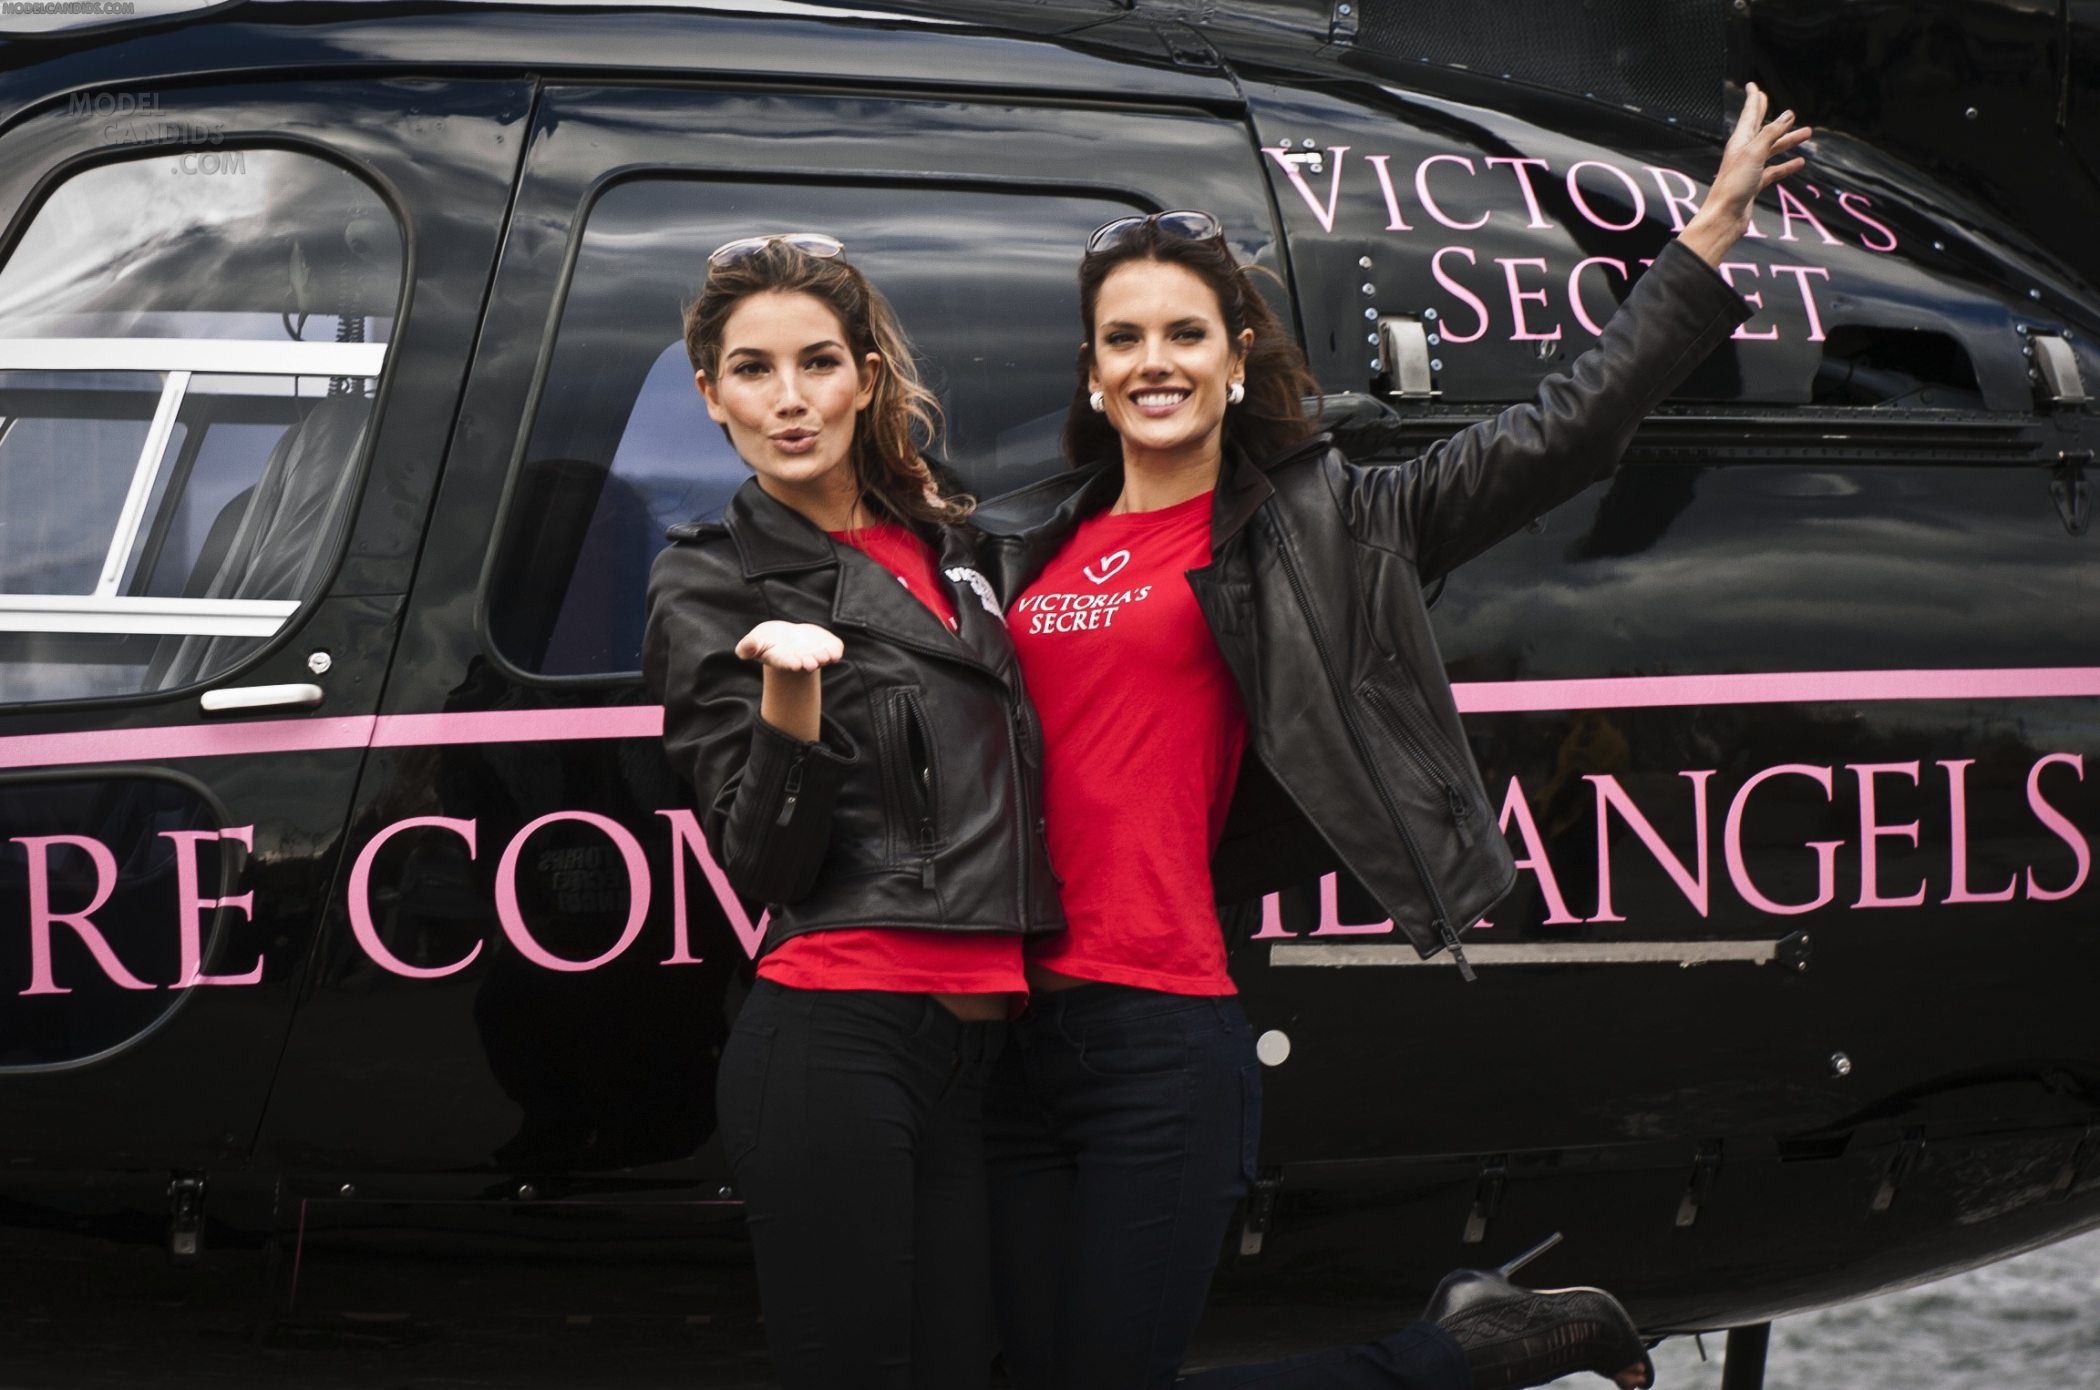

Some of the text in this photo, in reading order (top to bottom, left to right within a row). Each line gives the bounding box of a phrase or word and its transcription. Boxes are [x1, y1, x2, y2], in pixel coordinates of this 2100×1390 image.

[1261, 144, 1898, 252] VICTORA'S
[1430, 246, 1830, 344] SECET
[1018, 585, 1152, 612] VICTORIA'S
[1029, 606, 1119, 634] SECRET
[1474, 752, 2091, 928] ANGELS
